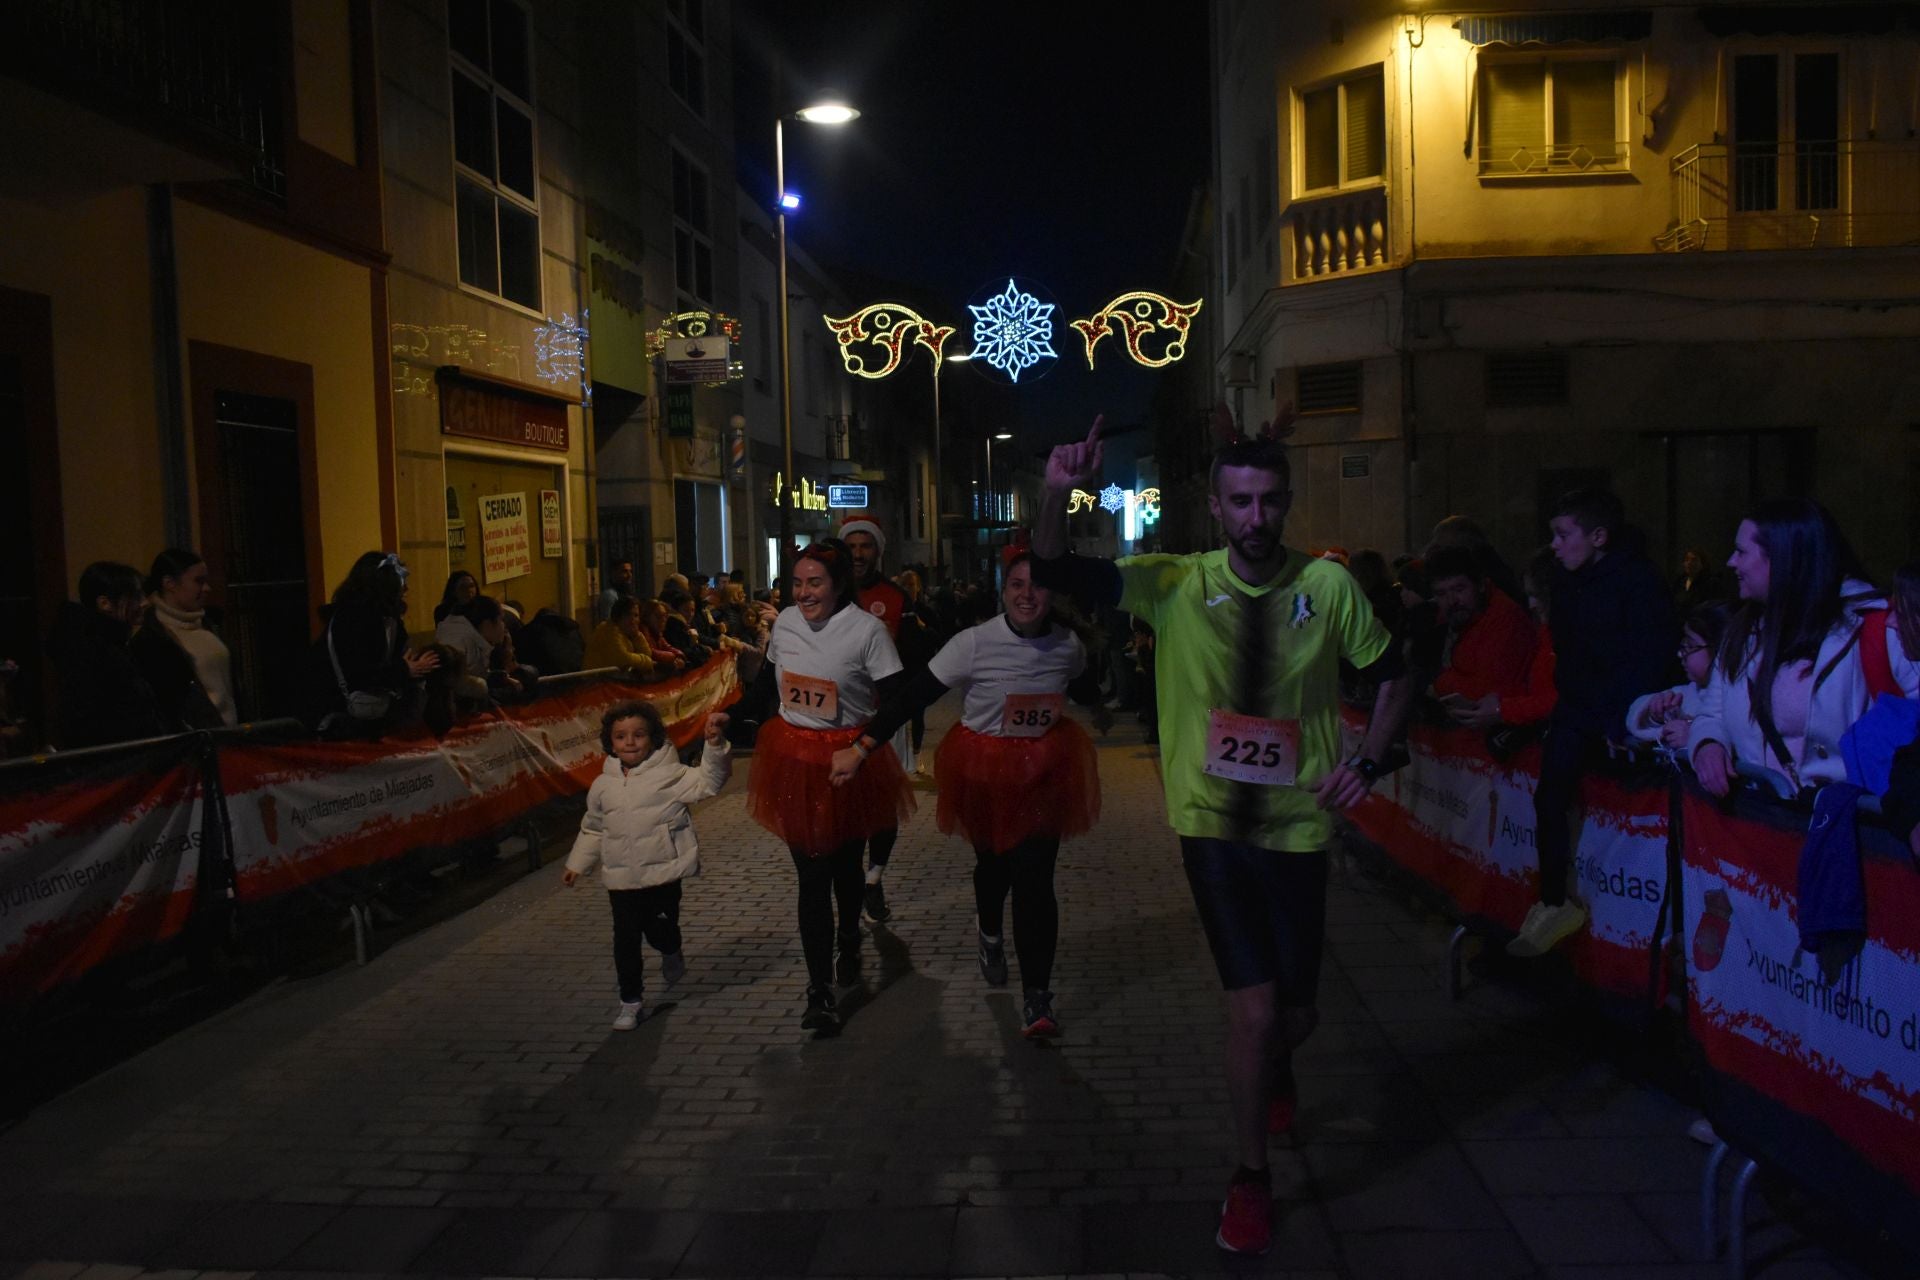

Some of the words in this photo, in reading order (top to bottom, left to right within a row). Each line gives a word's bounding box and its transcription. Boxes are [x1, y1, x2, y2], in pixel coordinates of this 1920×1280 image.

[525, 421, 565, 446] BOUTIQUE
[485, 498, 522, 521] CERRADO
[790, 688, 826, 708] 217
[1013, 709, 1051, 726] 385
[1219, 736, 1281, 768] 225
[291, 792, 367, 828] Ayuntamiento
[369, 786, 384, 803] de
[385, 773, 435, 799] Miajadas
